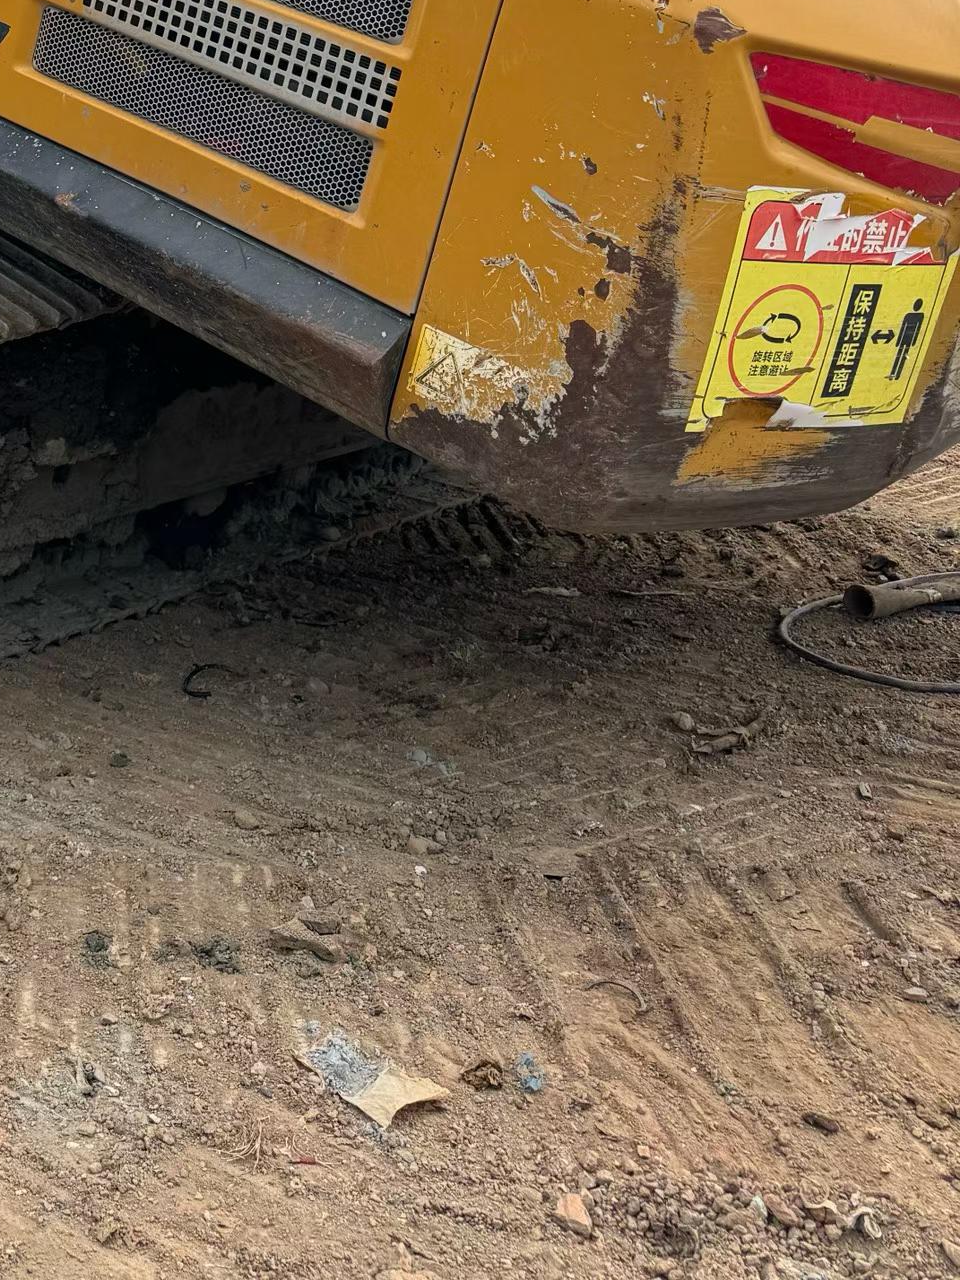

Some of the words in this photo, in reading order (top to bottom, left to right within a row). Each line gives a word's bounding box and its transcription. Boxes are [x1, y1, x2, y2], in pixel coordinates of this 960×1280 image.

[752, 350, 793, 362] 旋转区域
[829, 289, 874, 393] 保持距离
